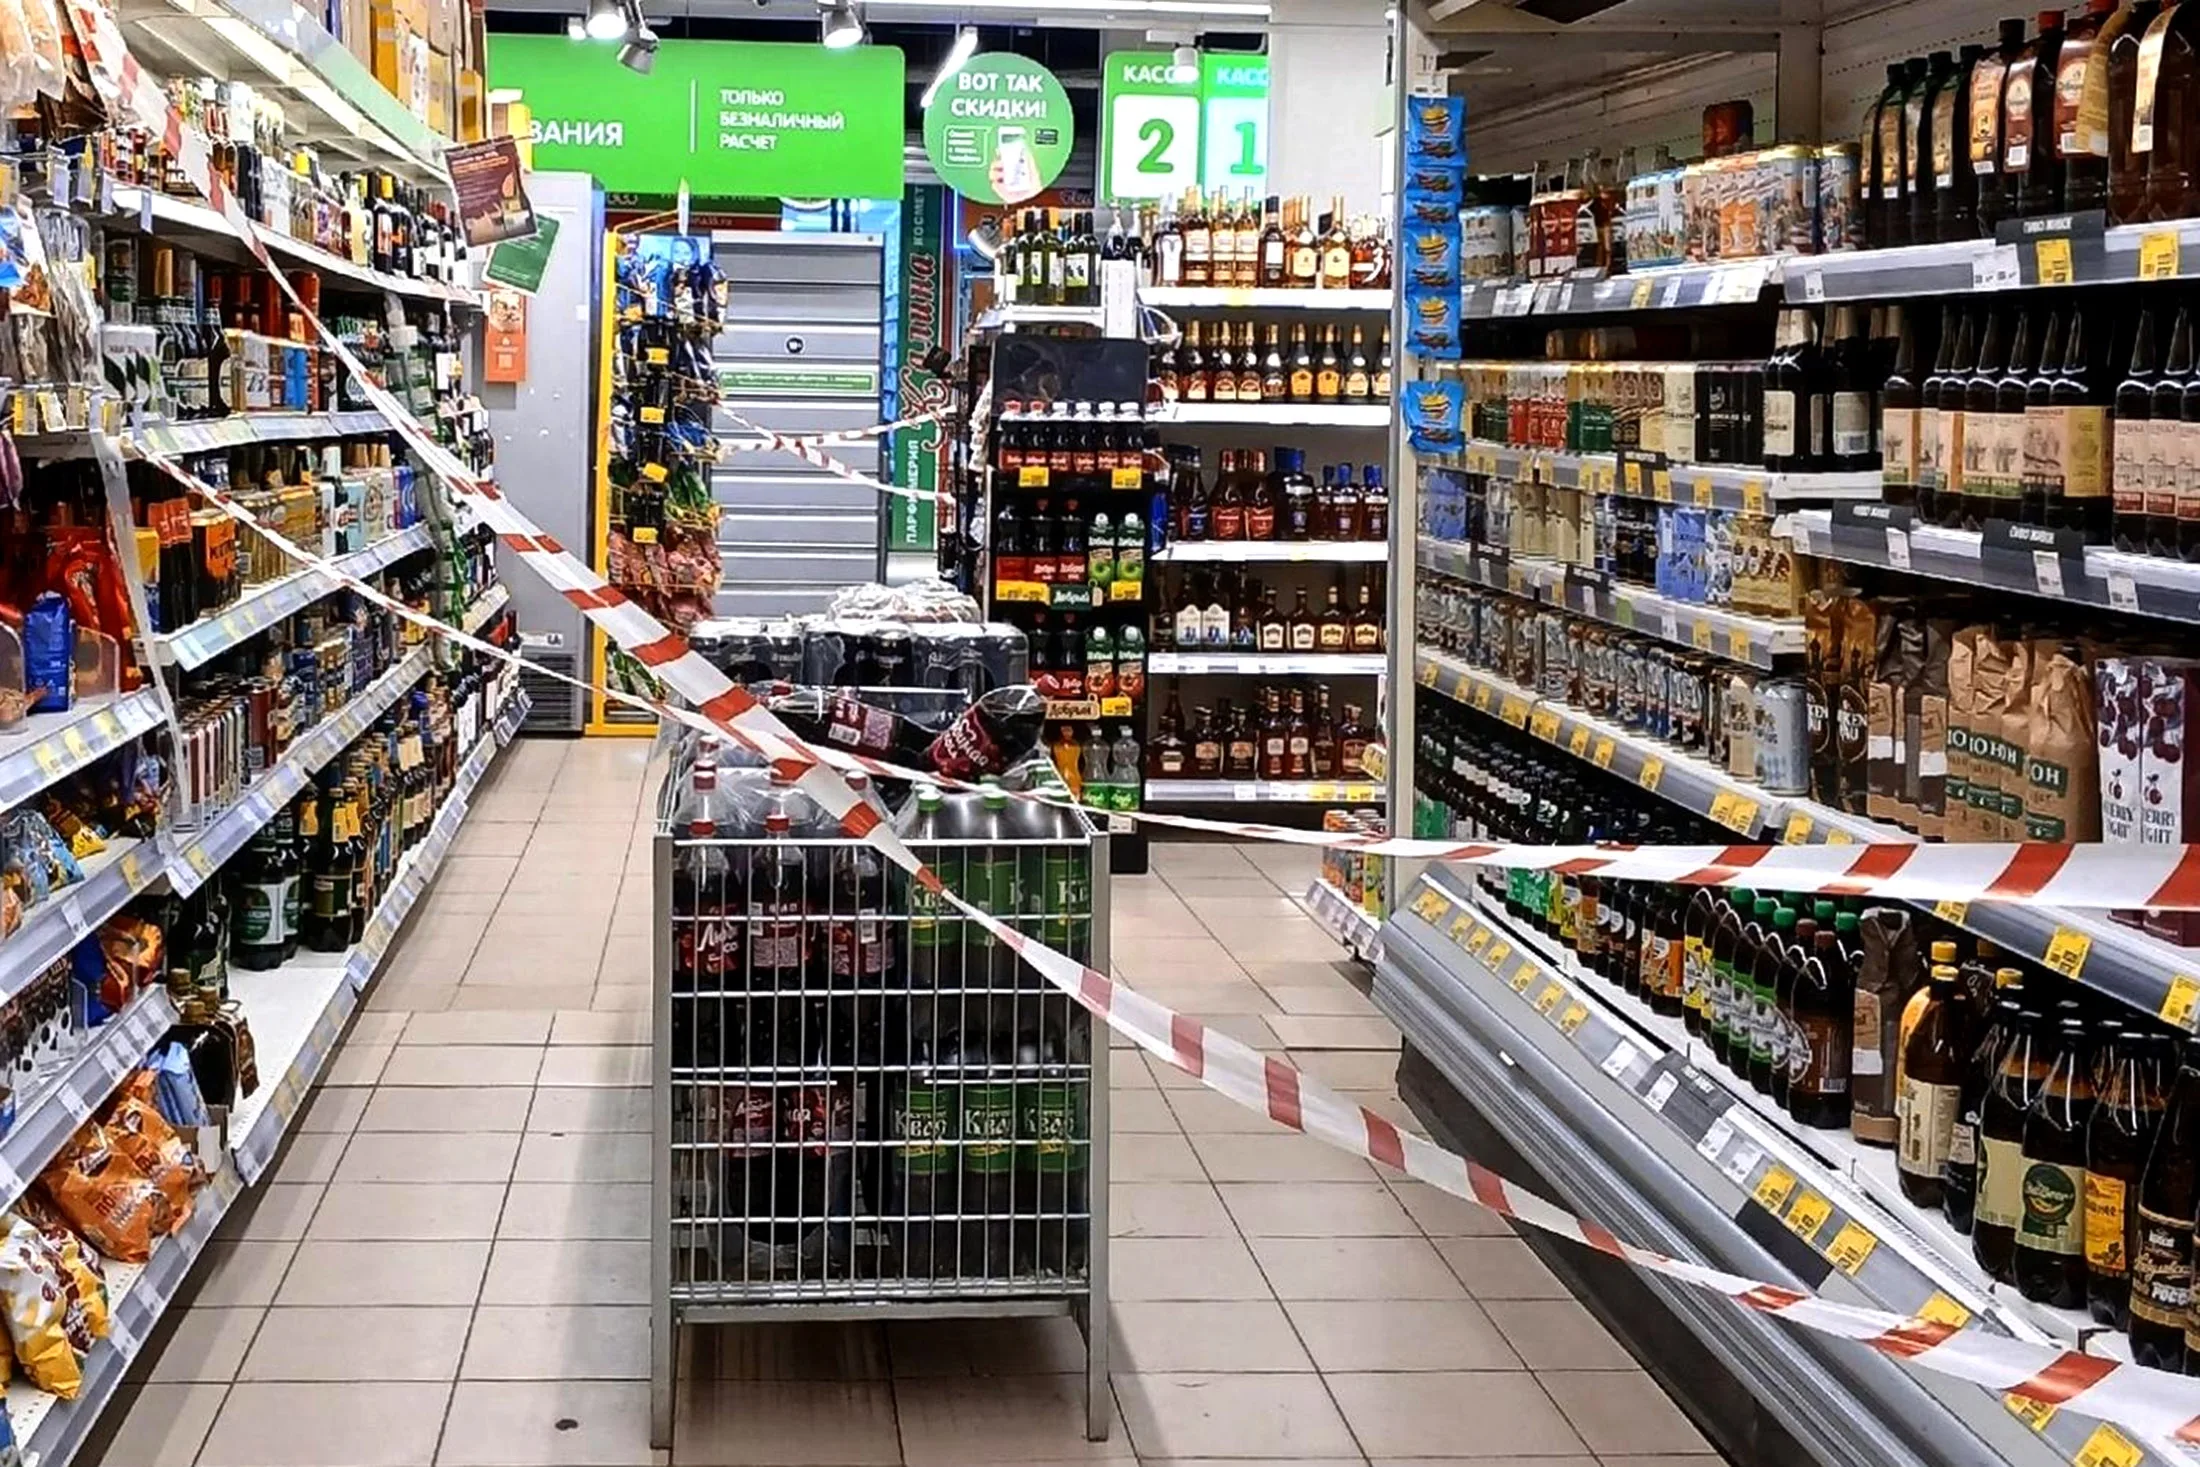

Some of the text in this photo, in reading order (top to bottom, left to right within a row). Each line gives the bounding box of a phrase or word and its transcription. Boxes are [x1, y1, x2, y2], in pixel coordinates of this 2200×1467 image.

[957, 71, 1044, 93] ВОТ ТАК
[1123, 64, 1176, 84] КАСС
[1217, 67, 1268, 87] КАСС
[719, 89, 785, 106] ТОЛЬКО
[951, 98, 1047, 119] СКИДКИ!
[719, 109, 845, 130] БЕЗНАЛИЧНЫЙ
[529, 120, 624, 148] ВАНИЯ
[719, 133, 778, 151] РАСЧЕТ
[1136, 118, 1174, 173] 2
[1230, 121, 1265, 175] 1
[906, 438, 920, 544] ПАРФМЕРИЯ
[913, 185, 926, 247] КОСМЕТ
